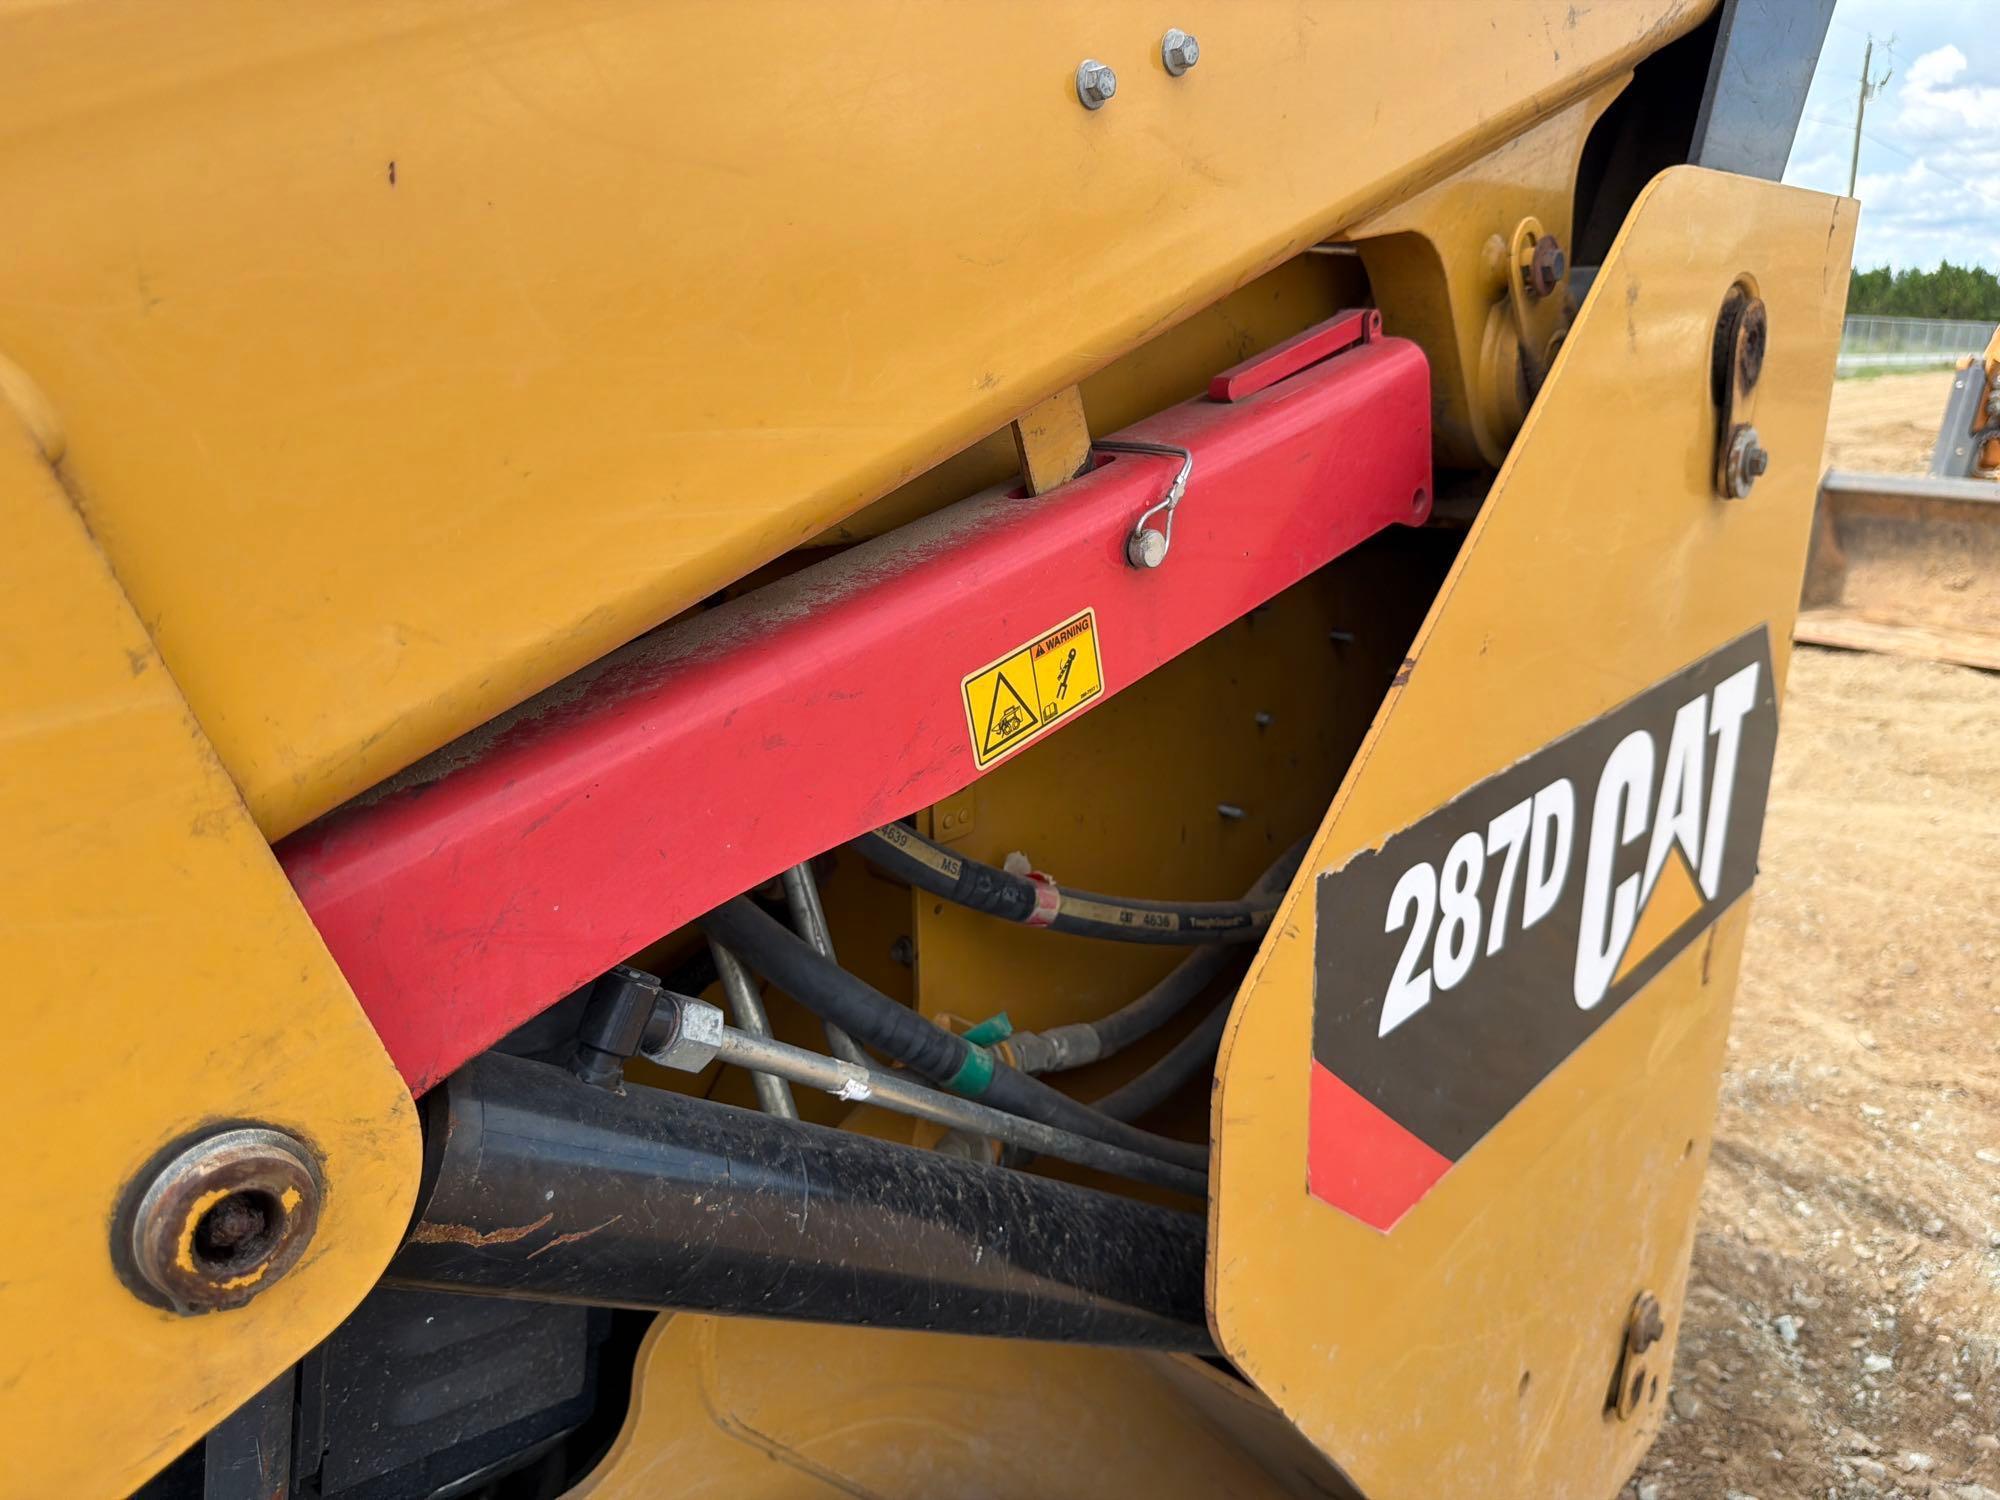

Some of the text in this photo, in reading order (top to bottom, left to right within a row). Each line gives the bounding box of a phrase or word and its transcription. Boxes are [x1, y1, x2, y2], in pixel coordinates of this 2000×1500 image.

[1046, 619, 1089, 650] WARNING
[1378, 661, 1761, 1038] 287D CAT
[940, 857, 960, 875] MS
